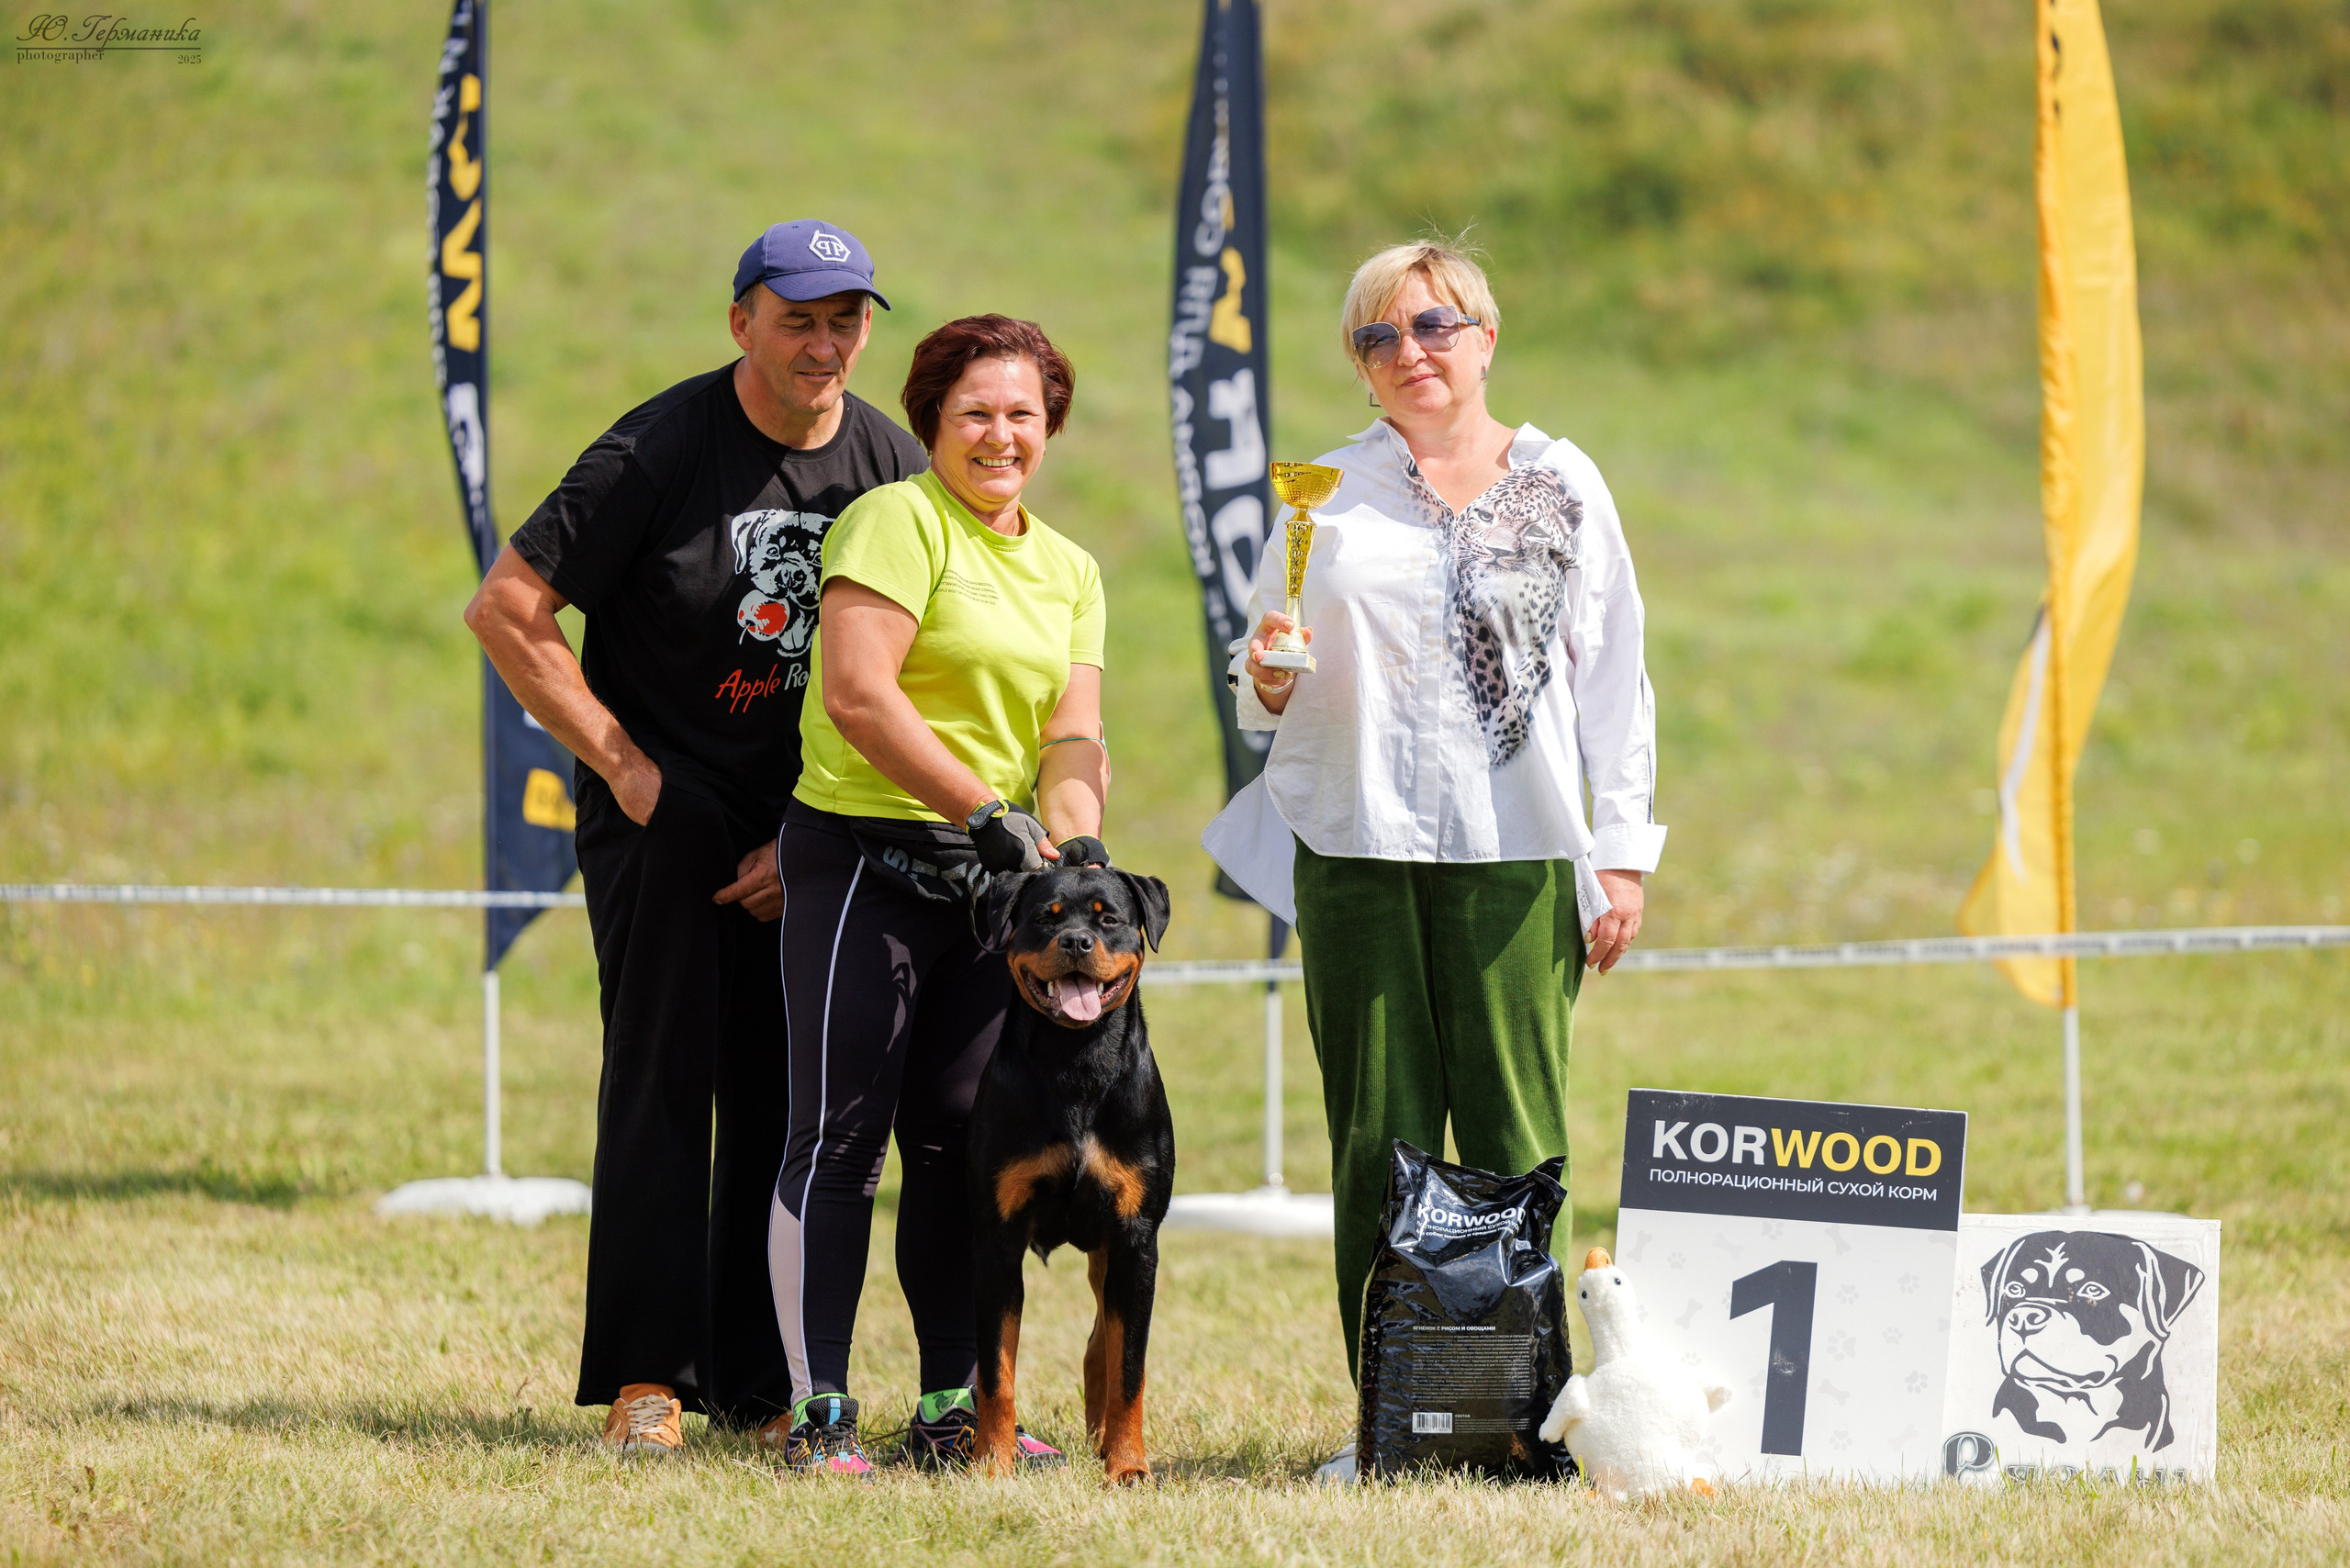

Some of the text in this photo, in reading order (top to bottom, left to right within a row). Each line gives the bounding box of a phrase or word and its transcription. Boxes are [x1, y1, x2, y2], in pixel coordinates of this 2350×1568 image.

[715, 663, 810, 714] Apple Ro
[1651, 1119, 1942, 1178] KORWOOD
[1650, 1168, 1938, 1202] ПОЛНОРАЦИОННЫЙ СУХОЙ КОРМ
[1416, 1202, 1527, 1228] KORWOOD
[1729, 1260, 1818, 1457] 1
